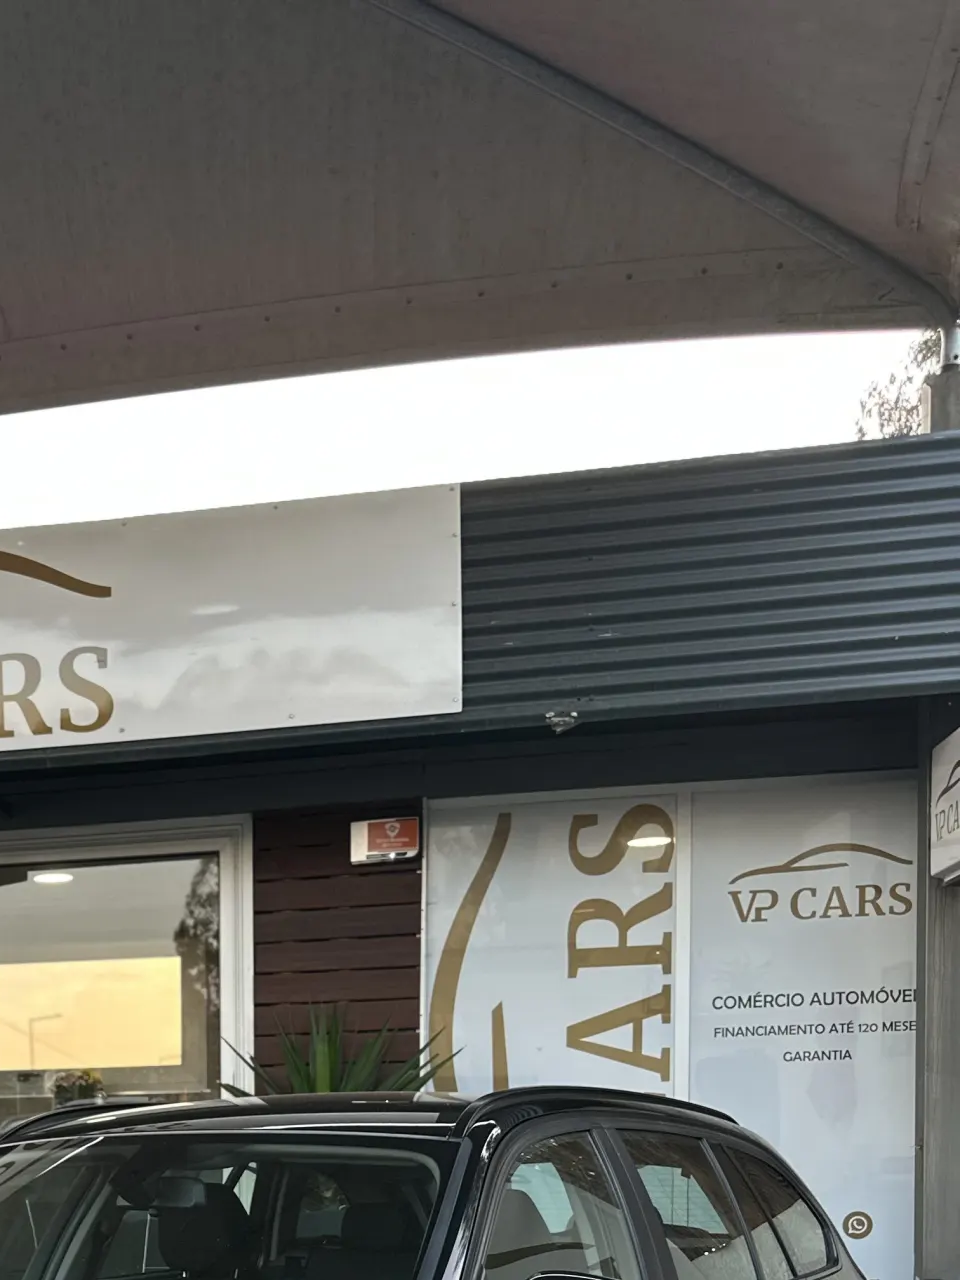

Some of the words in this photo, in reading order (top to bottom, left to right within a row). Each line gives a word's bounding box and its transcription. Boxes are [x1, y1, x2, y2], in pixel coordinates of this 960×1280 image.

[934, 809, 946, 841] VP
[727, 889, 779, 923] VP
[789, 882, 913, 921] CARS
[566, 803, 675, 1096] ARS
[711, 991, 805, 1010] COMÉRCIO
[713, 1023, 826, 1038] FINANCIAMENTO
[828, 1020, 855, 1034] ATÉ
[858, 1023, 878, 1033] 120
[782, 1049, 853, 1062] GARANTIA
